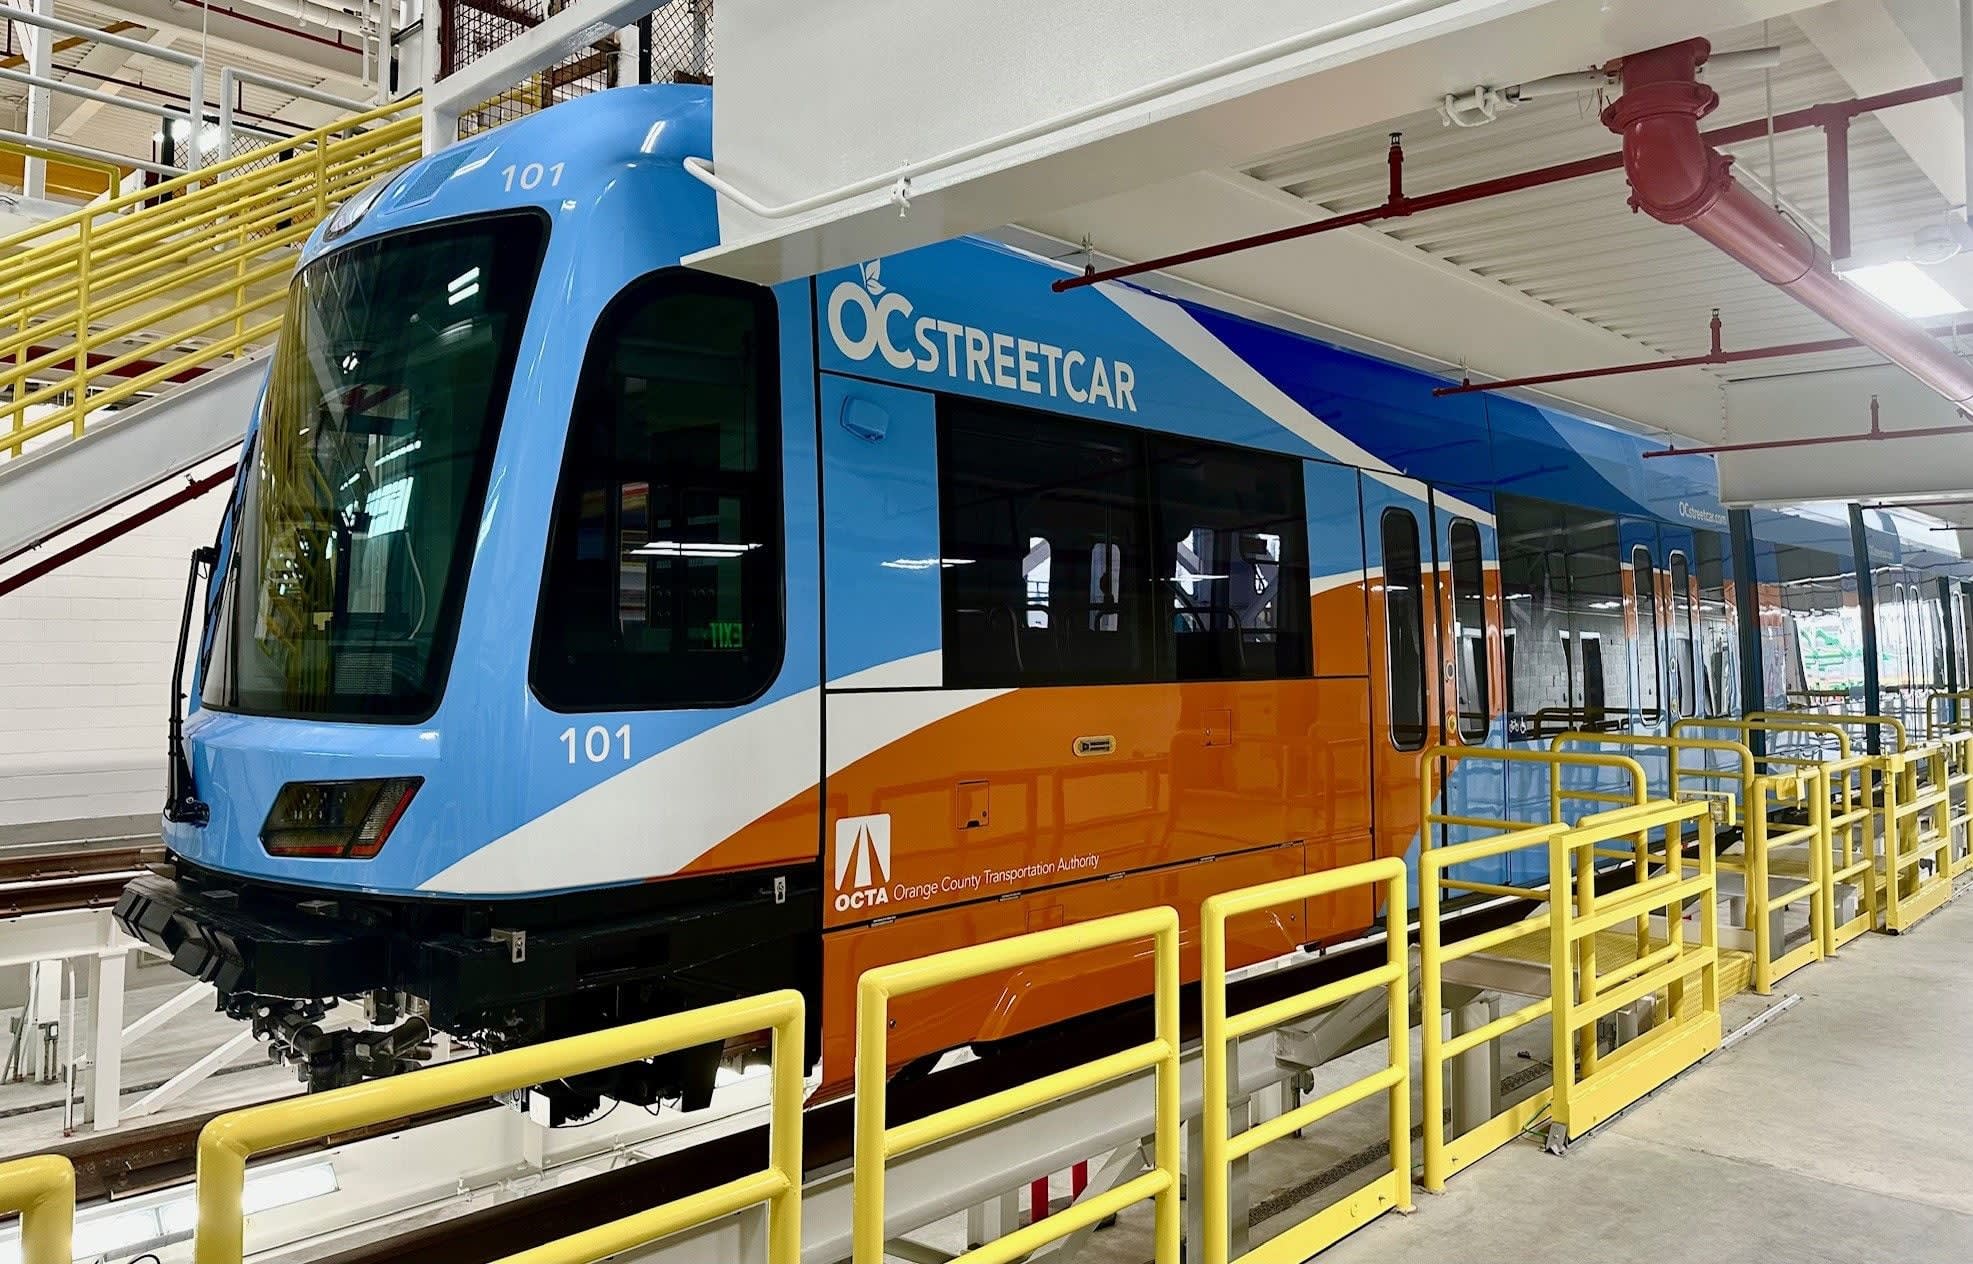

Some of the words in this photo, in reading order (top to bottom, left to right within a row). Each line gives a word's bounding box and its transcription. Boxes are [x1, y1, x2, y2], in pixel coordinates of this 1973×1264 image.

[501, 162, 565, 192] 101
[559, 724, 631, 764] 101
[893, 883, 938, 900] Orange
[941, 875, 981, 892] County
[983, 860, 1055, 885] Transportation
[1057, 852, 1100, 872] Authority
[834, 887, 889, 912] OCTA
